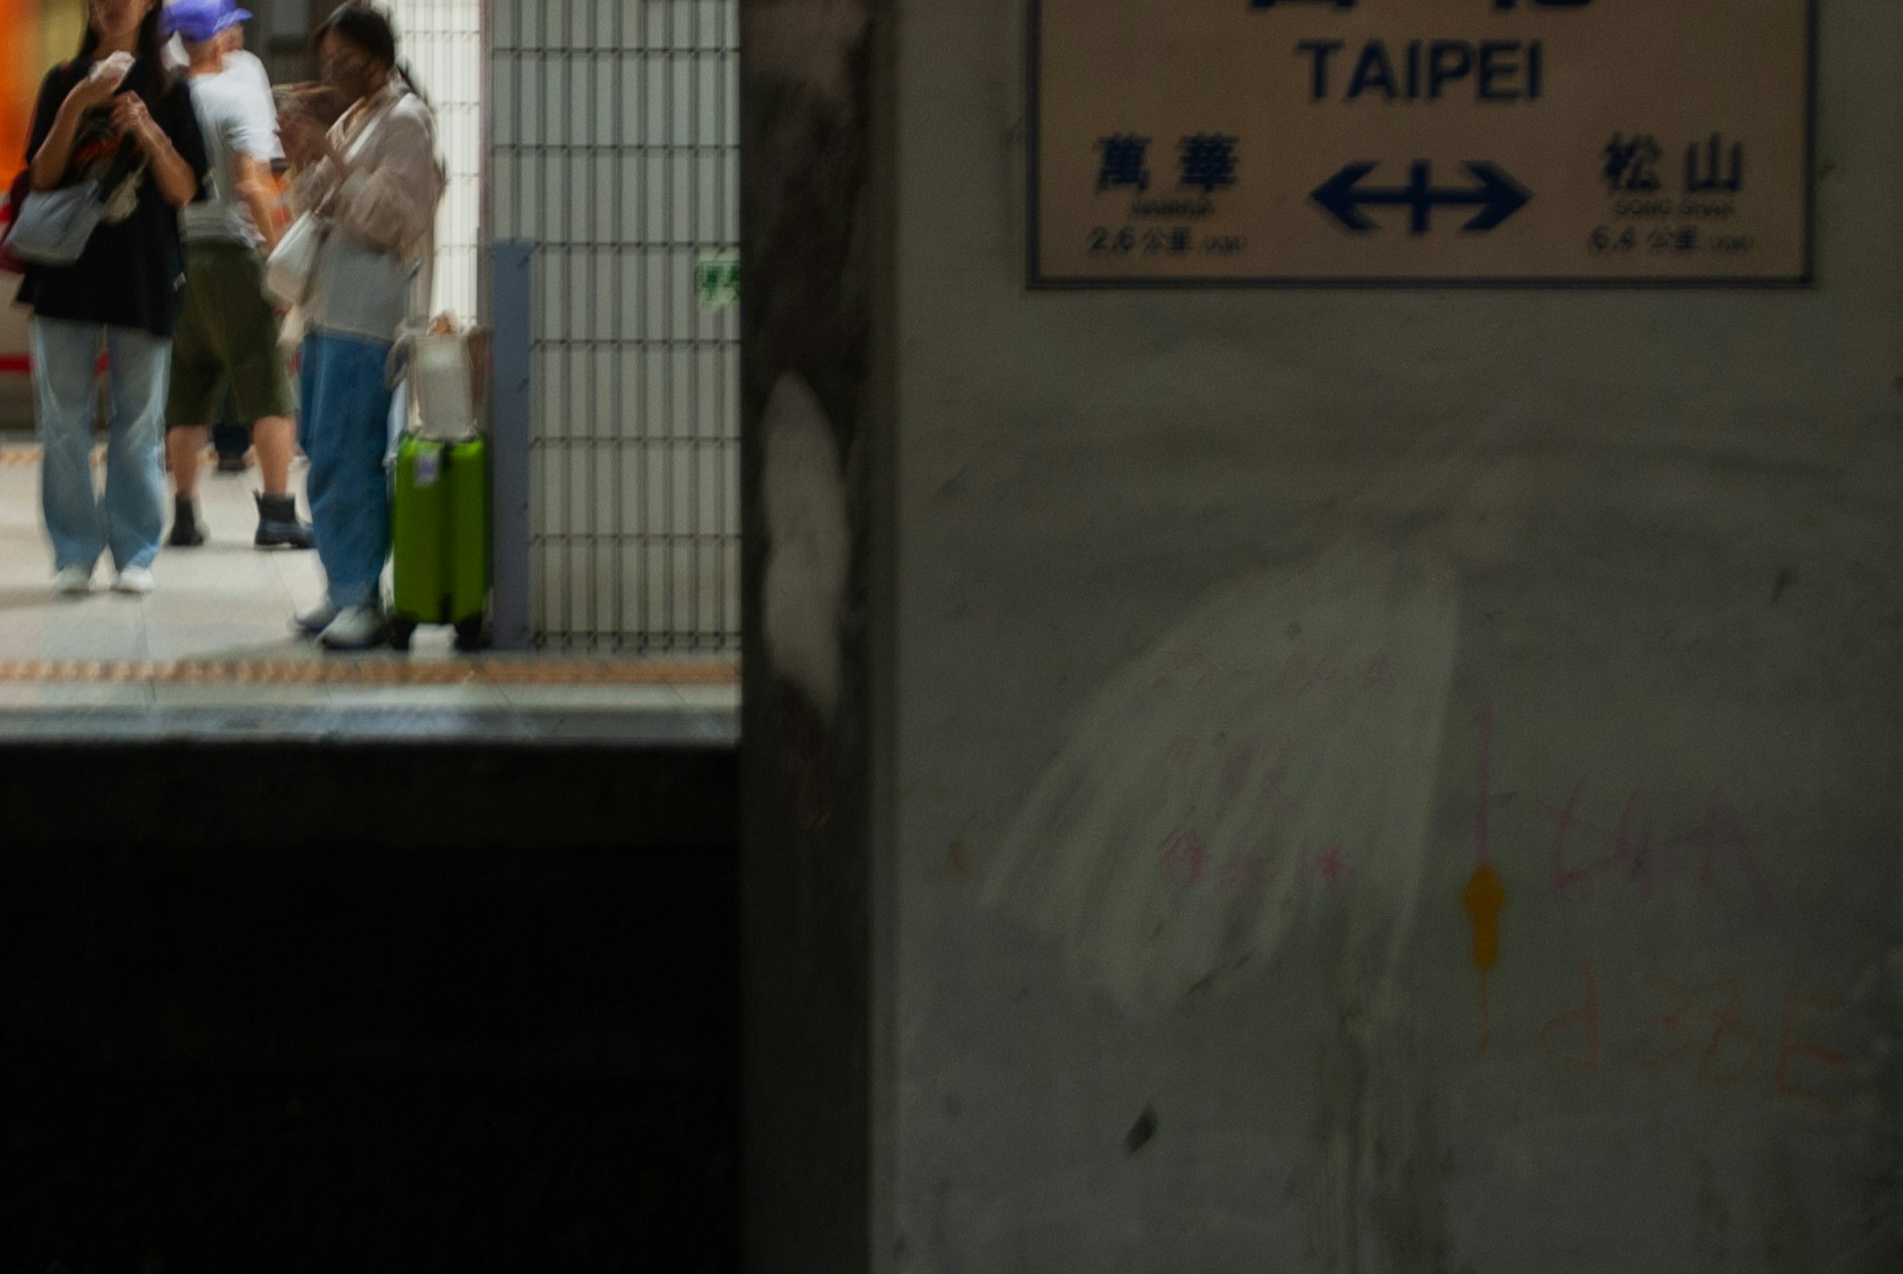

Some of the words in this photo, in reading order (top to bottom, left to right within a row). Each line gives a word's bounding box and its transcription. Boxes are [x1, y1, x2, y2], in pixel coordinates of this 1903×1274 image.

[1296, 39, 1544, 101] TAIPEI
[1096, 132, 1240, 191] 萬華
[1604, 132, 1743, 192] 松山
